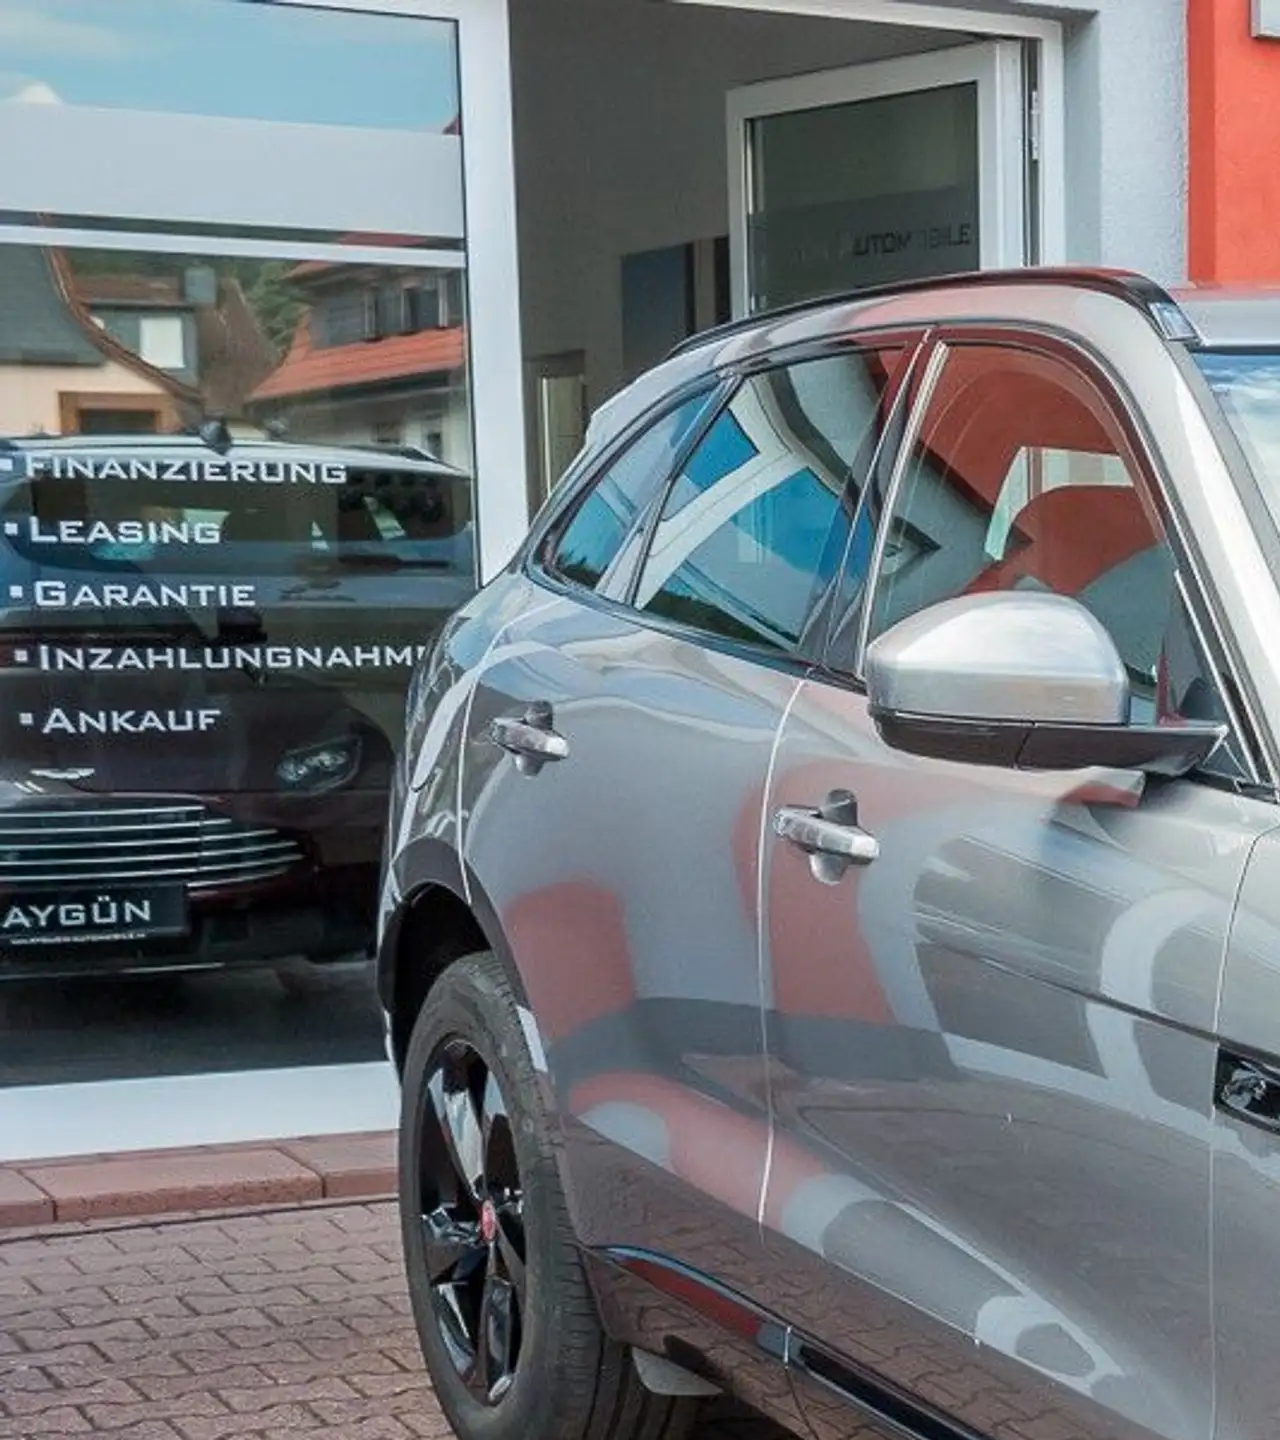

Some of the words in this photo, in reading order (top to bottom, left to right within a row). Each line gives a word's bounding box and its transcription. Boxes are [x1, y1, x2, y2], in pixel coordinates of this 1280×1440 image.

[25, 452, 347, 484] FINANZIERUNG
[29, 516, 221, 544] LEASING
[34, 580, 257, 607] GARANTIE
[42, 708, 222, 734] ANKAUF
[2, 895, 152, 928] AYGÜN
